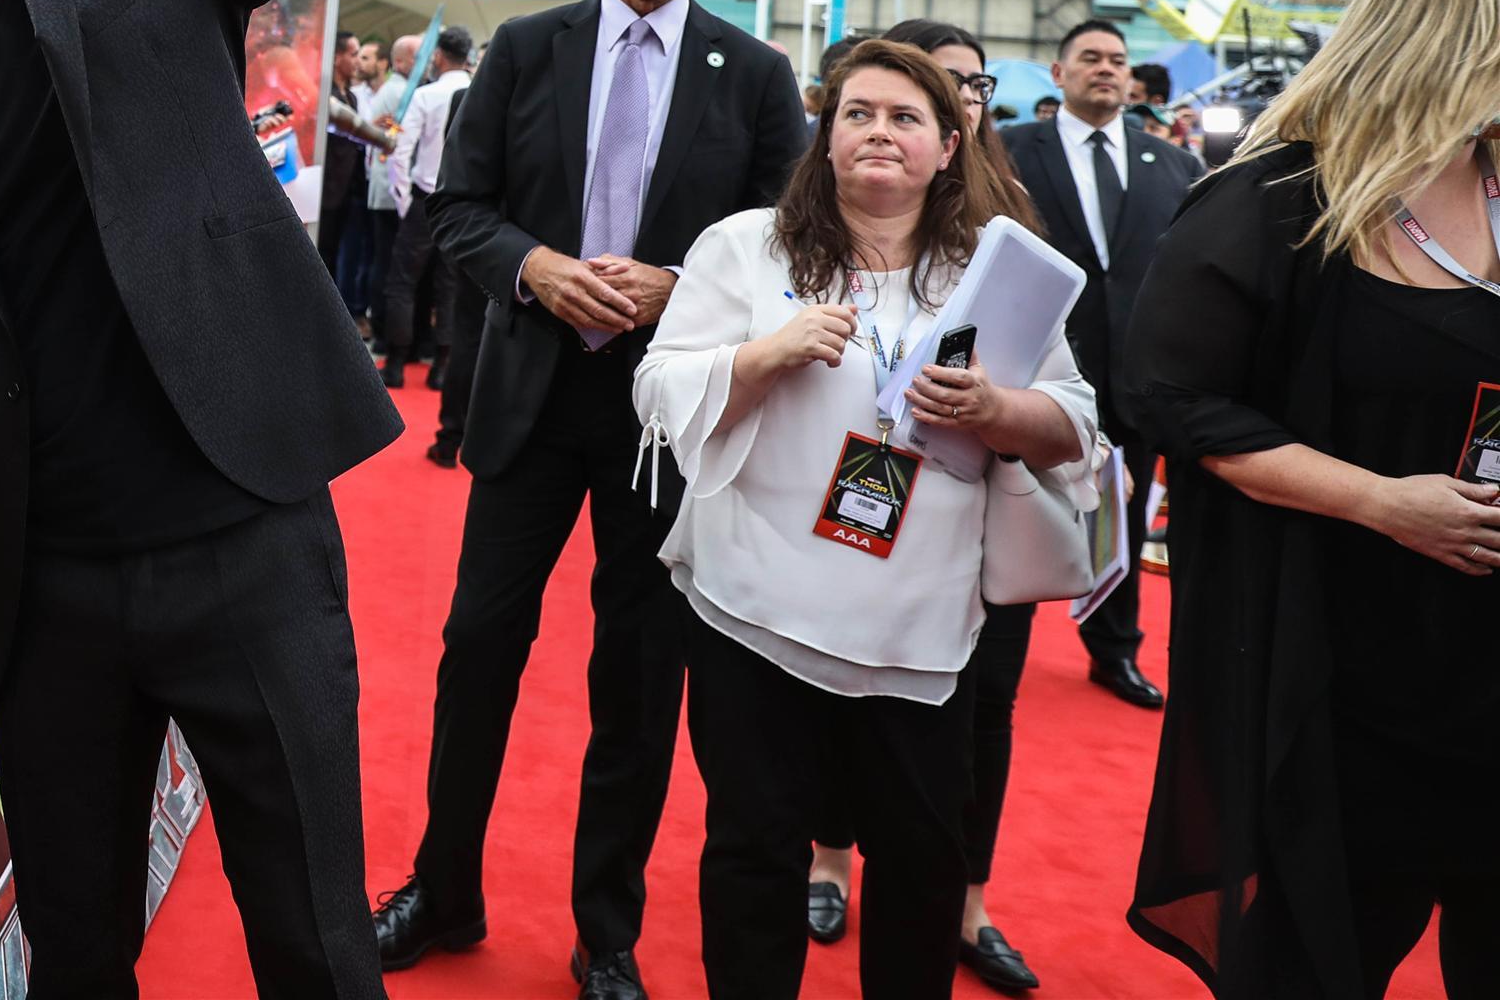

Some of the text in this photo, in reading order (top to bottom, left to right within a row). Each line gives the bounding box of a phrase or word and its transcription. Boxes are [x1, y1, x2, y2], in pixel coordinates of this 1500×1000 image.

[1403, 218, 1430, 243] MARVEL
[838, 479, 903, 508] RAGNAROK
[859, 478, 888, 493] THOR
[833, 529, 871, 549] AAA
